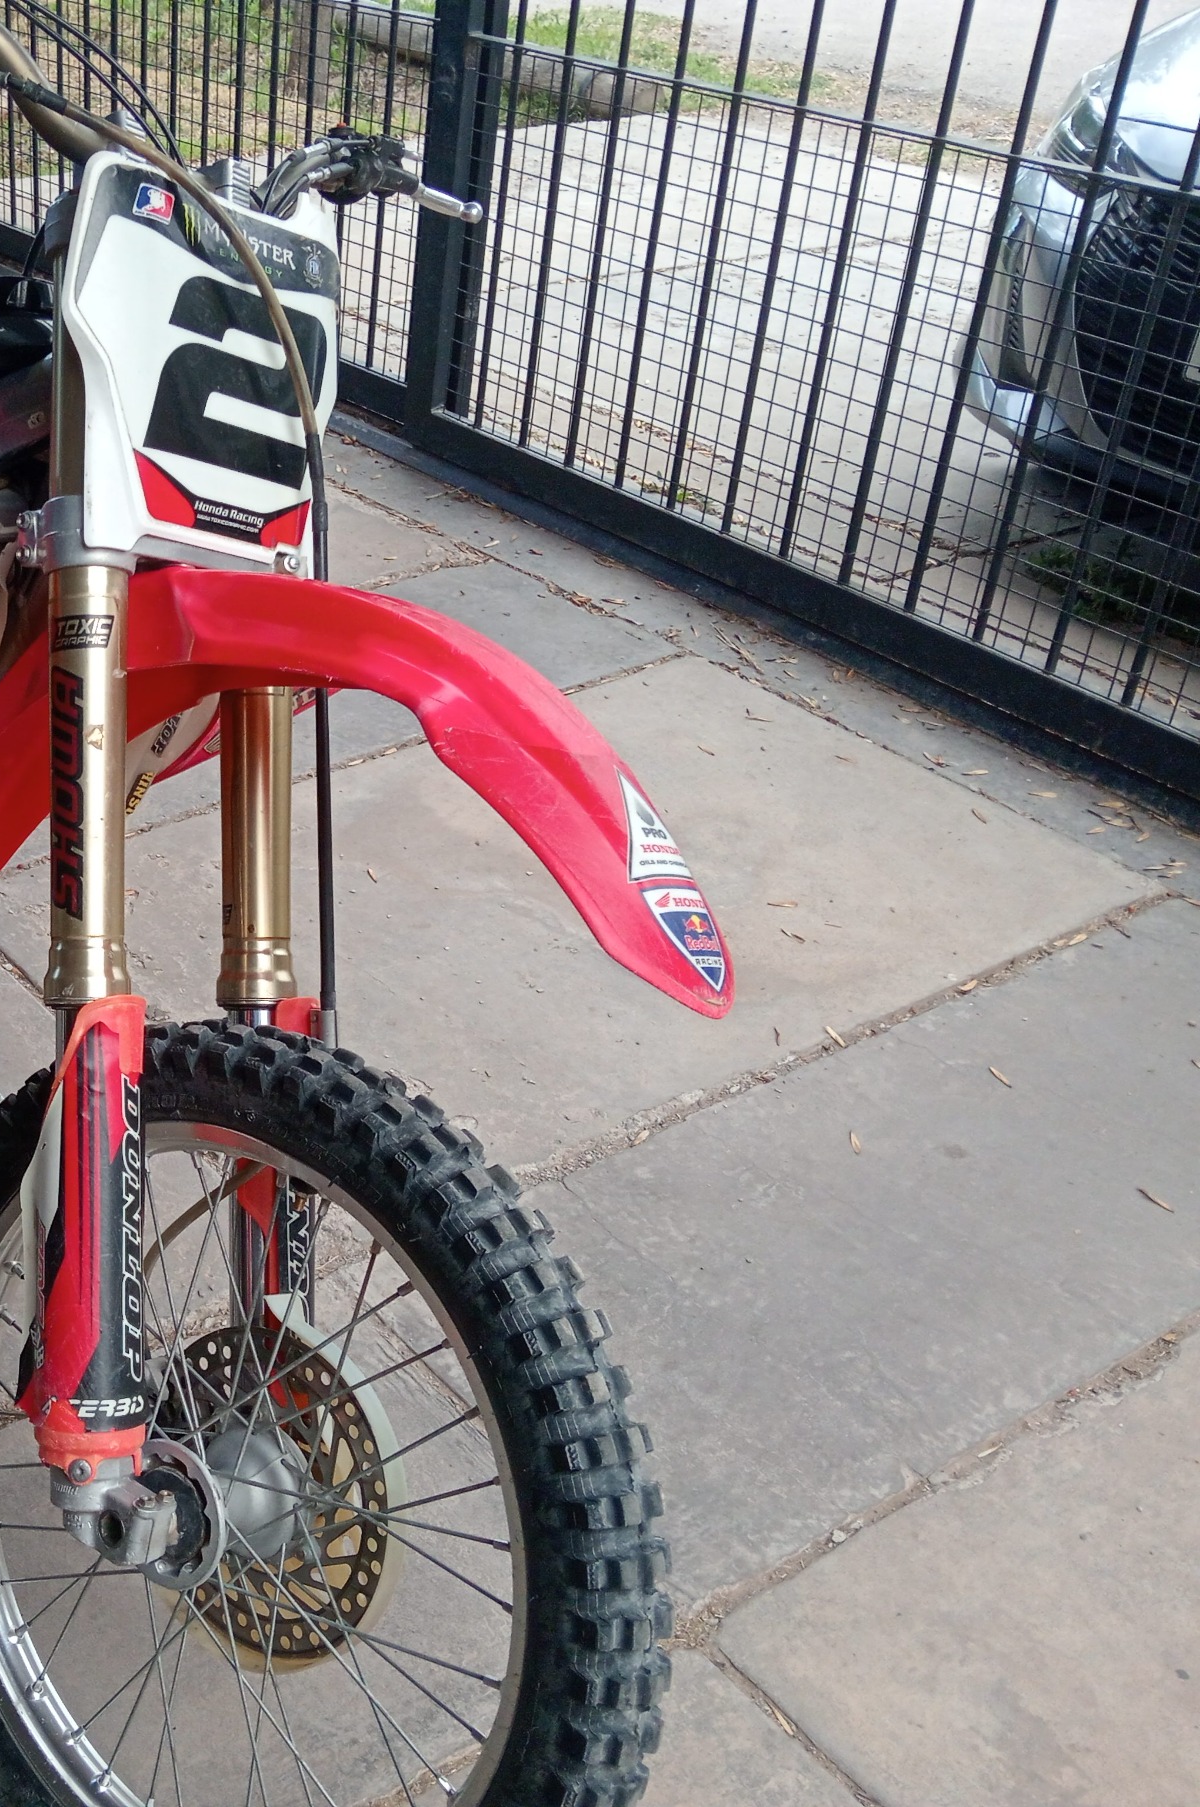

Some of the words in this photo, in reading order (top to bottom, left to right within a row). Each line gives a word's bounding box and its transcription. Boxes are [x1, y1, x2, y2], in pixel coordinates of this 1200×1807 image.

[204, 218, 296, 271] MSTER
[220, 248, 283, 279] ENGY
[143, 276, 327, 490] 2
[194, 500, 229, 517] Honda
[229, 509, 265, 529] Racing
[58, 617, 112, 636] TOXIC
[51, 665, 84, 921] SHOWA
[641, 827, 668, 840] PRO
[695, 958, 723, 966] RACING
[121, 1074, 143, 1383] DUNLOP
